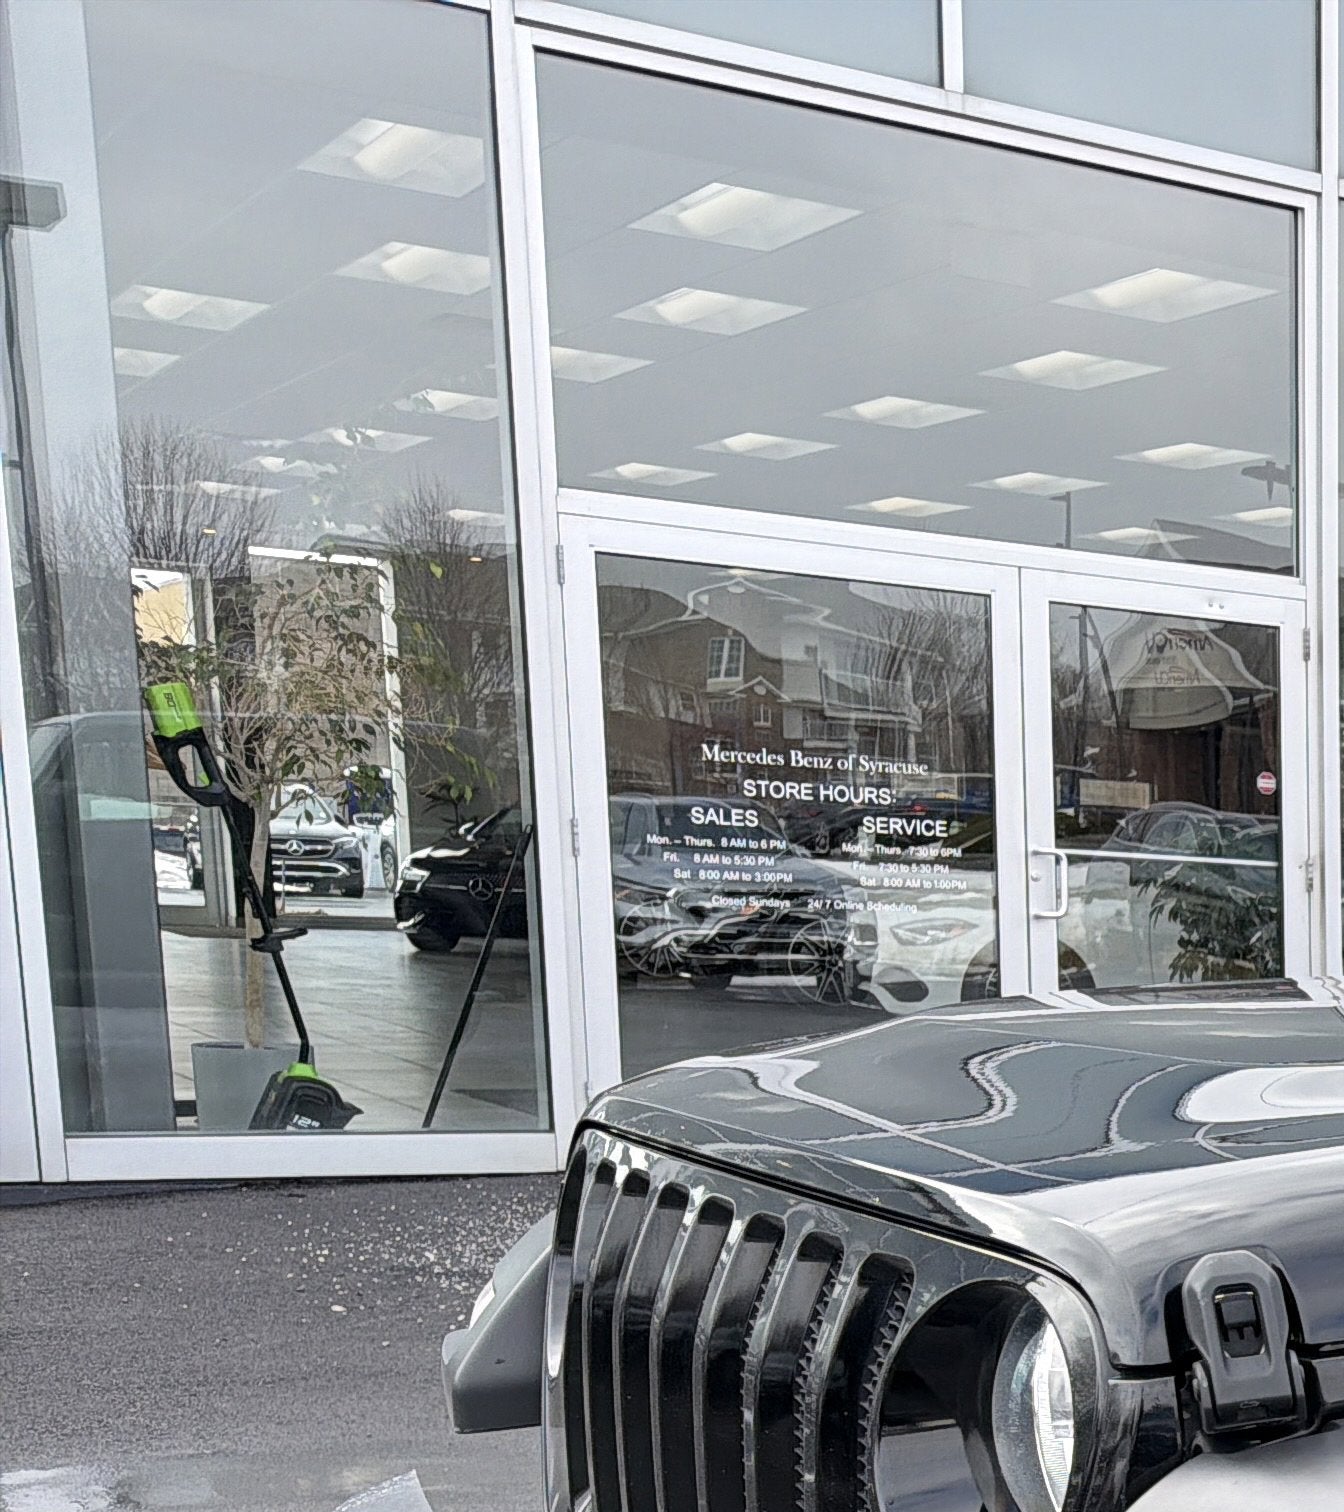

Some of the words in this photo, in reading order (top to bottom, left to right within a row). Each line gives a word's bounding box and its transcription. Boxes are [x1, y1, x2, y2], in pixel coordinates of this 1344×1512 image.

[701, 743, 785, 766] Mercedes
[790, 750, 833, 769] Benz
[837, 754, 856, 771] of
[859, 755, 929, 776] Syracuse
[743, 779, 814, 801] STORE
[820, 784, 897, 805] HOURS:
[690, 806, 759, 828] SALES
[862, 816, 948, 837] SERVICE
[646, 833, 672, 846] Mon.
[683, 835, 716, 848] Thurs.
[730, 837, 747, 849] AM
[748, 839, 759, 849] to
[769, 840, 787, 850] PM
[663, 851, 680, 863] Fri.
[702, 853, 720, 864] AM
[721, 855, 732, 865] to
[733, 855, 756, 866] 5:30
[758, 856, 775, 867] PM
[930, 848, 939, 857] to
[722, 870, 740, 881] AM
[741, 872, 752, 882] to
[900, 863, 910, 873] to
[911, 863, 932, 874] 5:30
[934, 864, 950, 875] PM
[905, 879, 921, 889] AM
[923, 880, 932, 889] to
[711, 894, 747, 907] Closed
[748, 896, 791, 909] Sundays
[833, 900, 865, 911] Online
[866, 902, 918, 913] Scheduling
